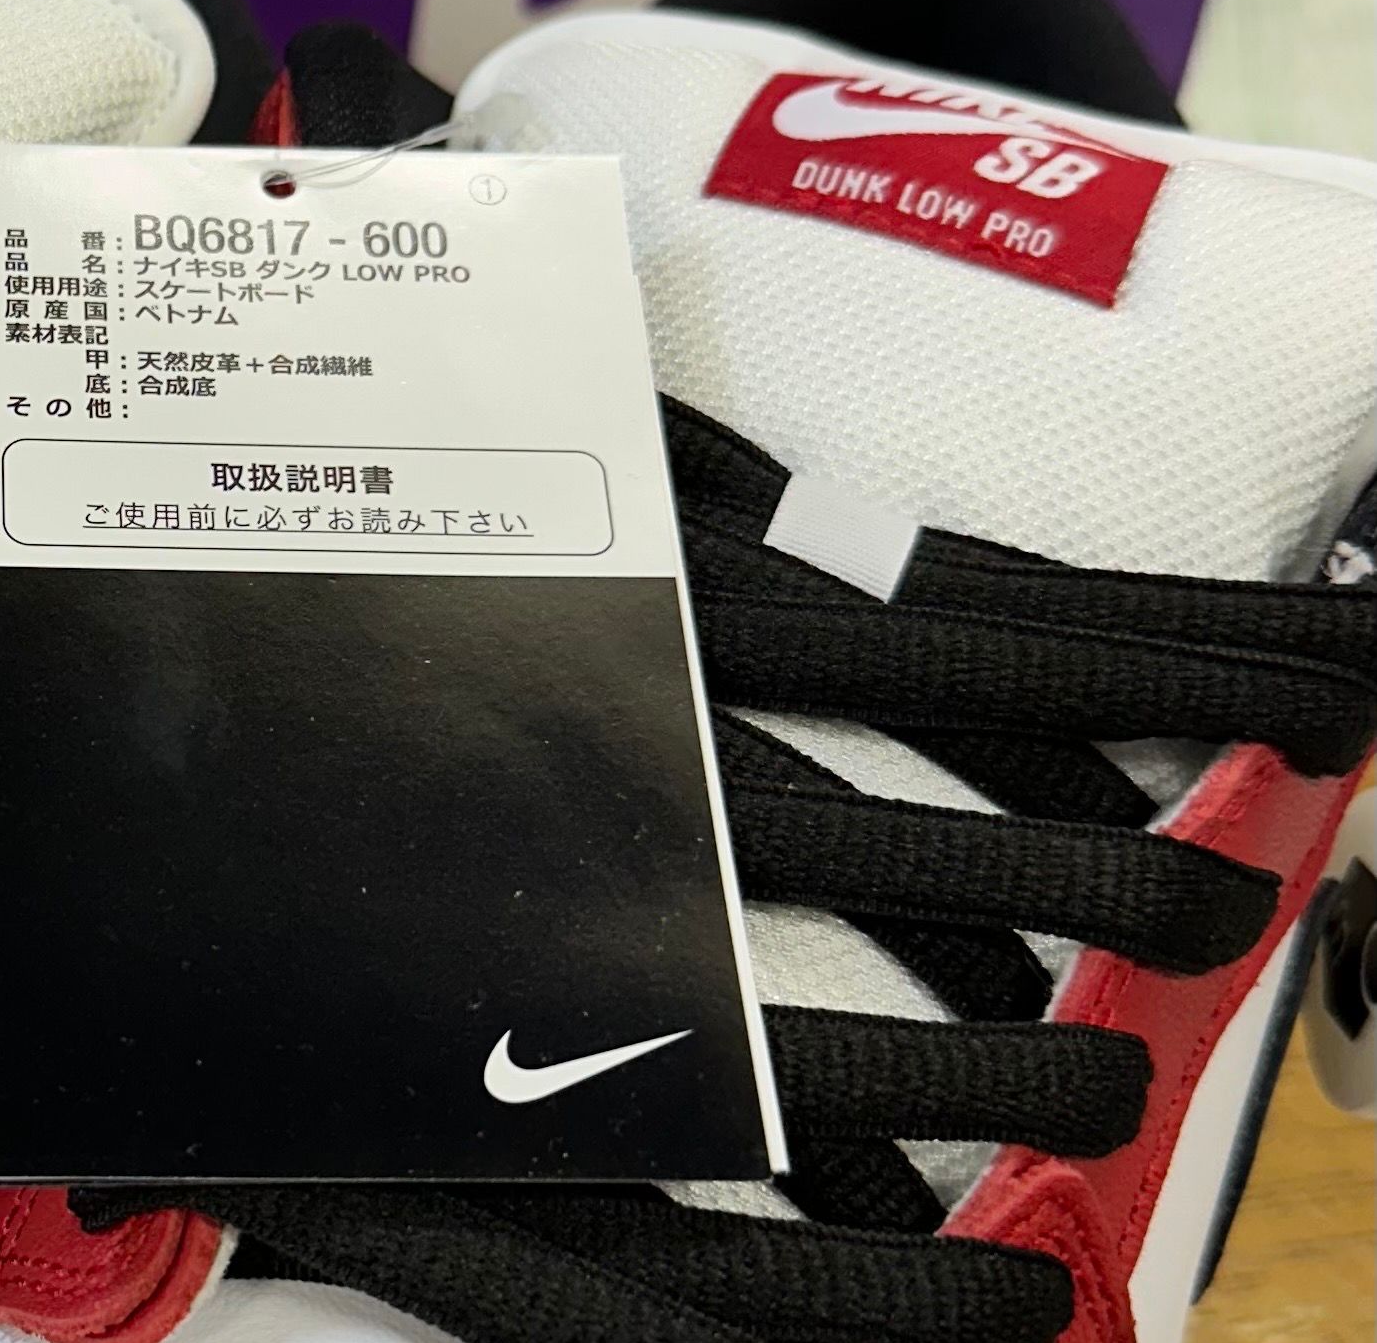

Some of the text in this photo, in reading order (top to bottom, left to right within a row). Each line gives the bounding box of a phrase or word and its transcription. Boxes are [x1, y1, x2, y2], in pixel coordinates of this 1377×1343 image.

[973, 137, 1103, 199] SB
[791, 159, 1056, 258] DUNK LOW PRO
[134, 214, 311, 256] BQ6817
[362, 221, 448, 258] 600
[133, 256, 246, 279] ナイキSB
[256, 259, 330, 281] ダンク
[343, 264, 404, 282] LOW
[415, 265, 470, 283] PRO
[5, 322, 109, 345] 素材表記
[211, 463, 394, 495] 取扱説明書
[84, 502, 528, 535] ご使用前に必ずお読み下さい
